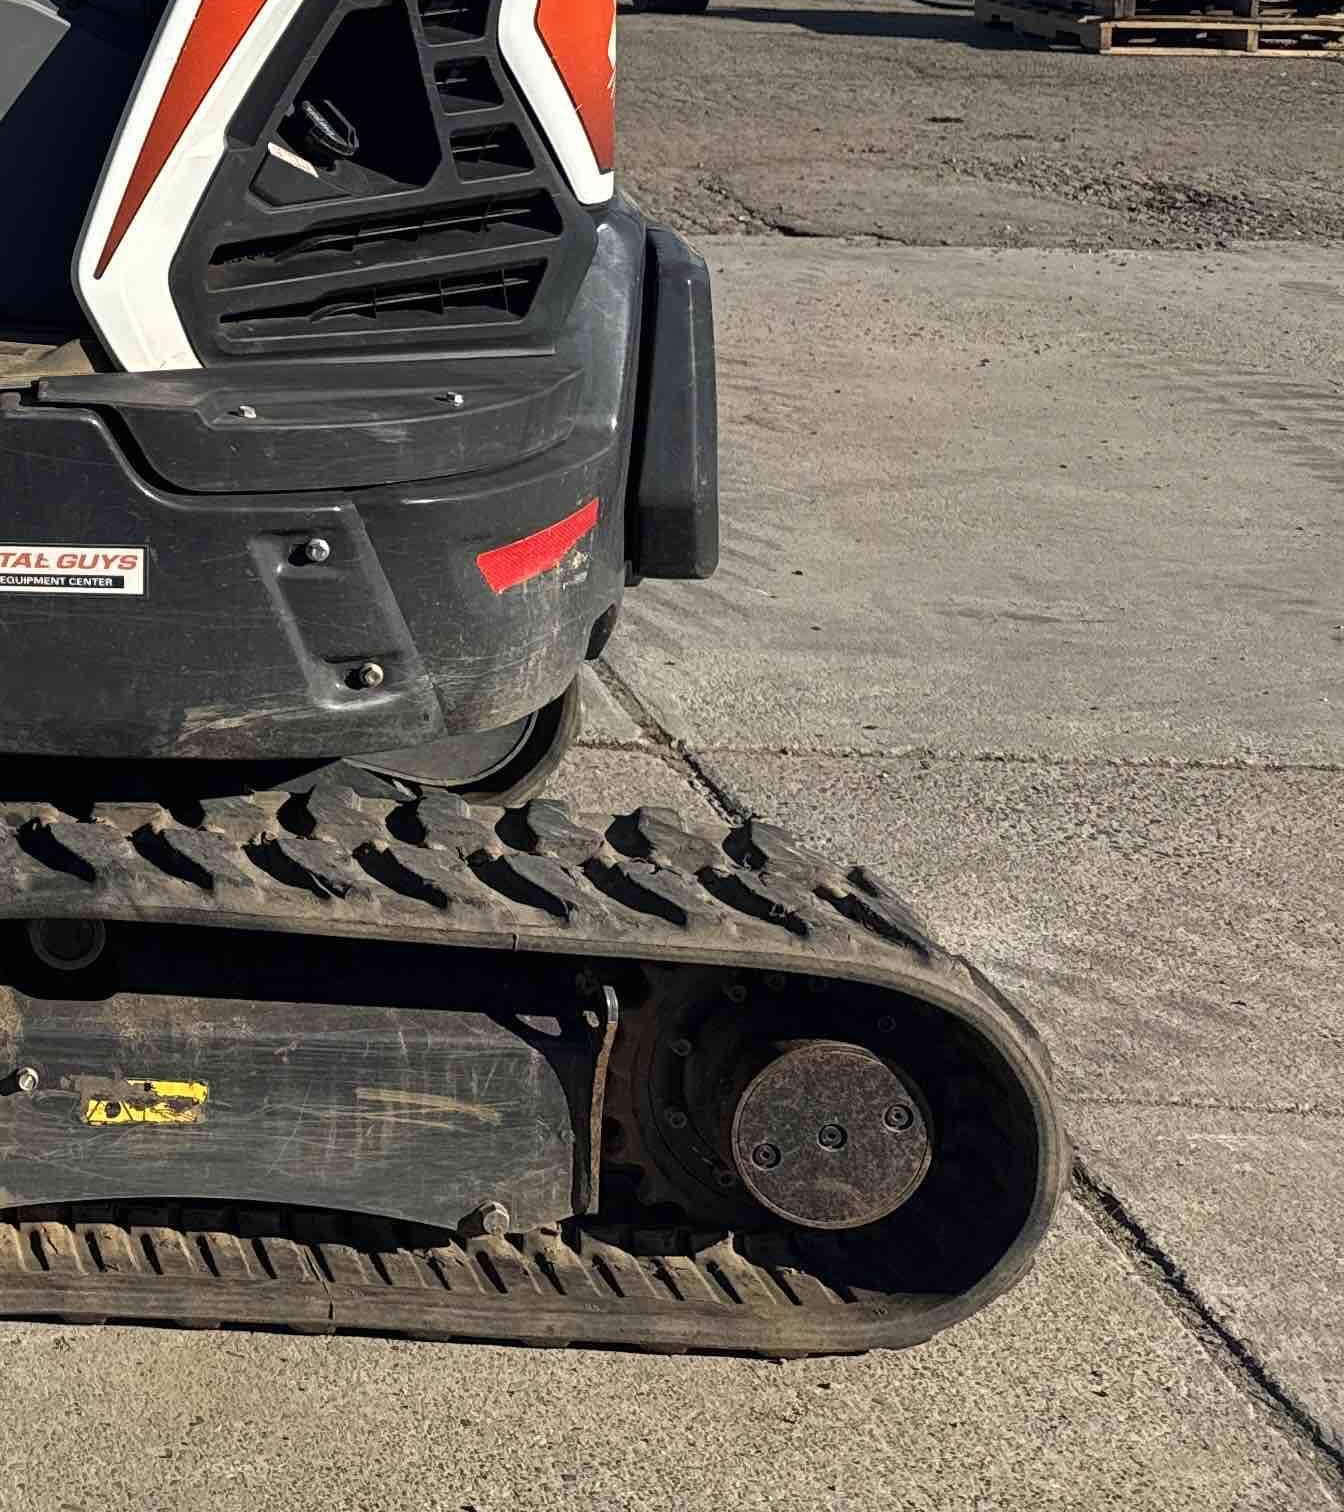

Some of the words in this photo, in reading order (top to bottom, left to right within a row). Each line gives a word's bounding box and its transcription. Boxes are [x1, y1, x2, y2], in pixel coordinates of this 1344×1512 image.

[56, 553, 138, 570] GUYS
[0, 575, 66, 586] EQUIPMENT
[68, 577, 113, 587] CENTER
